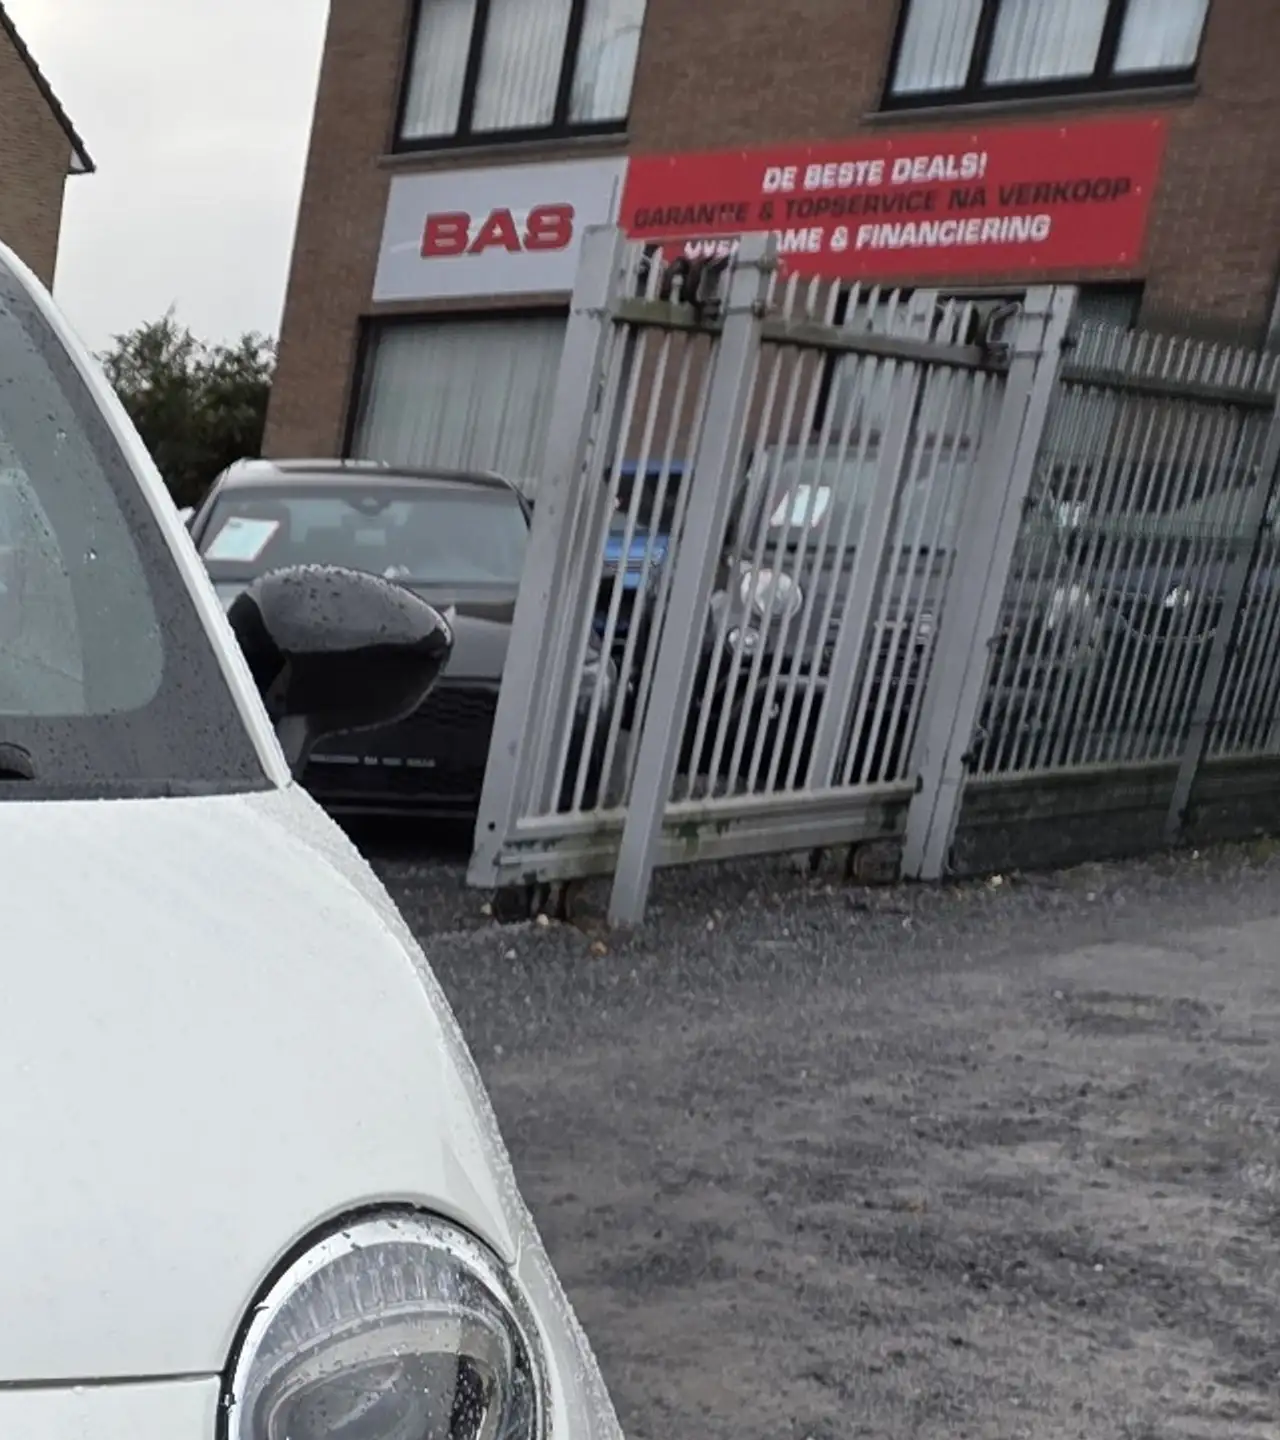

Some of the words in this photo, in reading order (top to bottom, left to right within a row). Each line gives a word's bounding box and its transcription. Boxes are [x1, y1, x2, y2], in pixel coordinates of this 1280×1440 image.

[762, 165, 797, 193] DE
[804, 159, 885, 190] BESTE
[891, 152, 988, 183] DEALS!
[758, 200, 775, 223] &
[786, 189, 938, 221] TOPSERVICE
[948, 187, 988, 212] NA
[998, 177, 1132, 208] VERKOOP
[420, 202, 575, 259] BAS
[829, 225, 849, 252] &
[855, 214, 1053, 251] FINANCIERING
